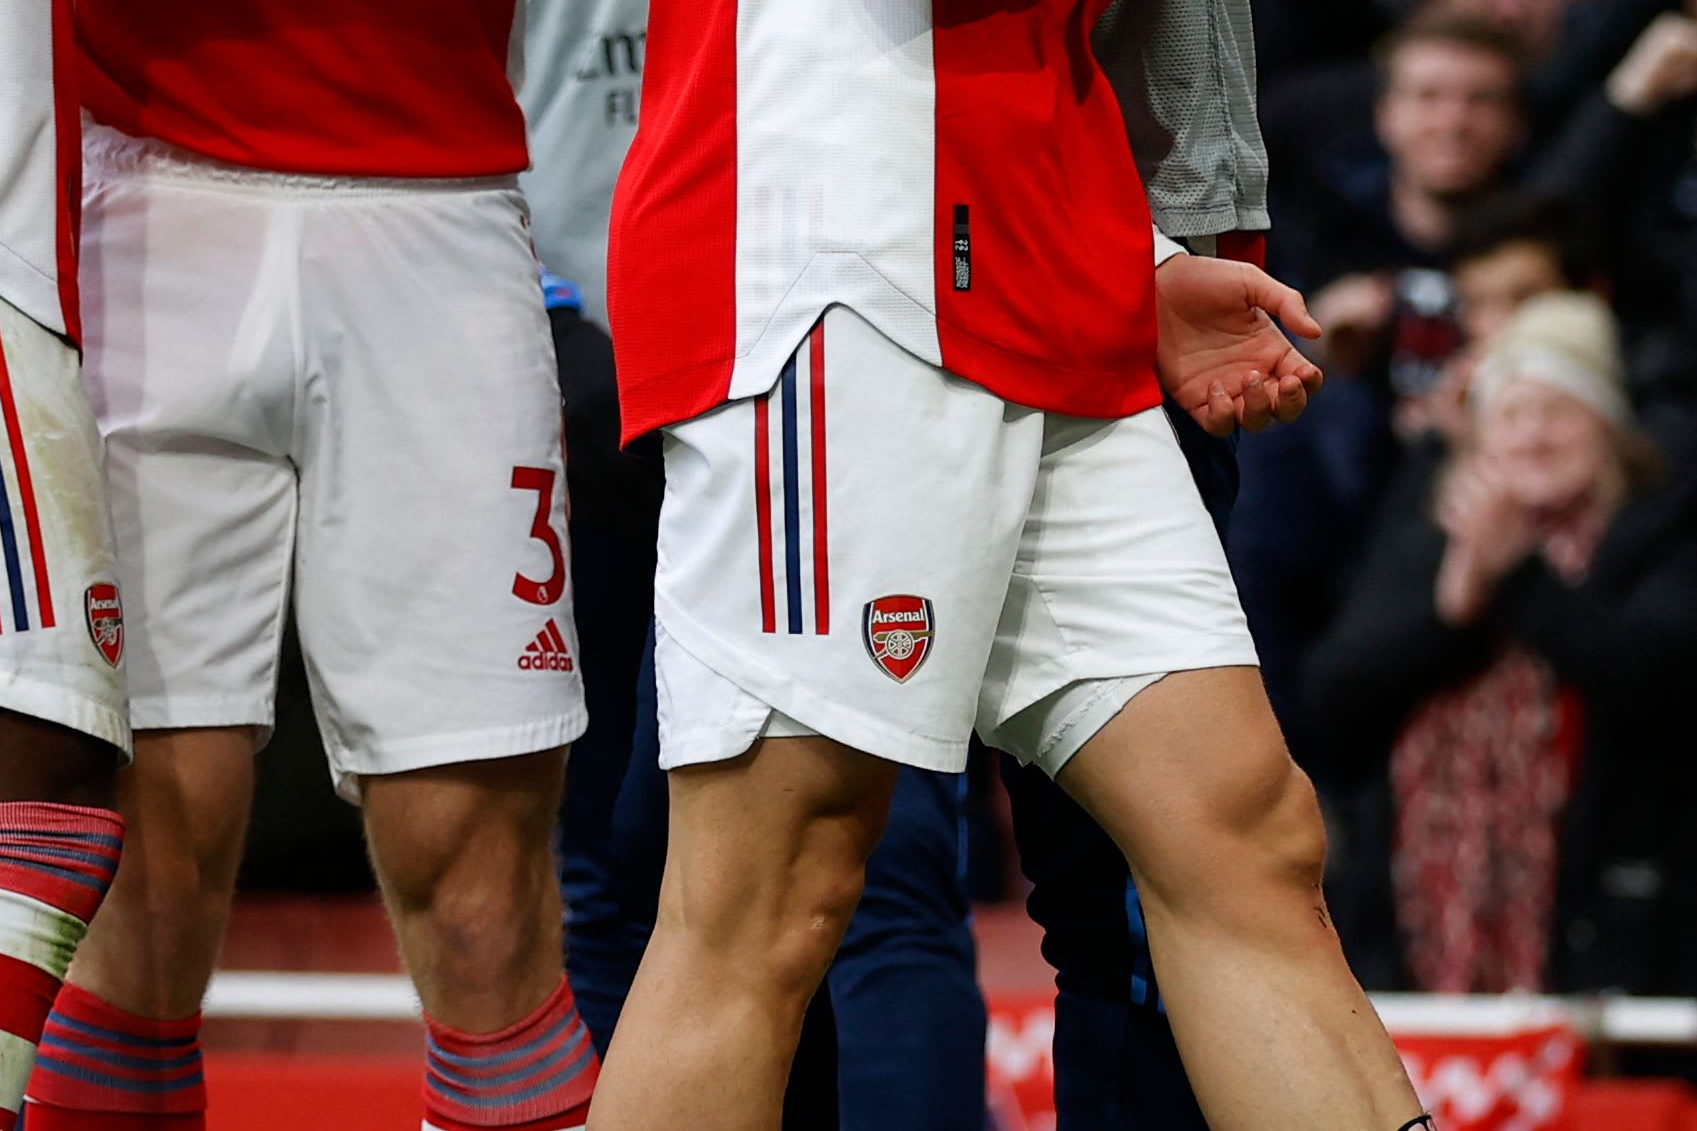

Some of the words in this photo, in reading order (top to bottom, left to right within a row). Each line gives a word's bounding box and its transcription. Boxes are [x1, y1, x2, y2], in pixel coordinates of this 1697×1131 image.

[510, 466, 566, 606] 3
[871, 608, 925, 624] Arsenal
[517, 652, 574, 672] adidas
